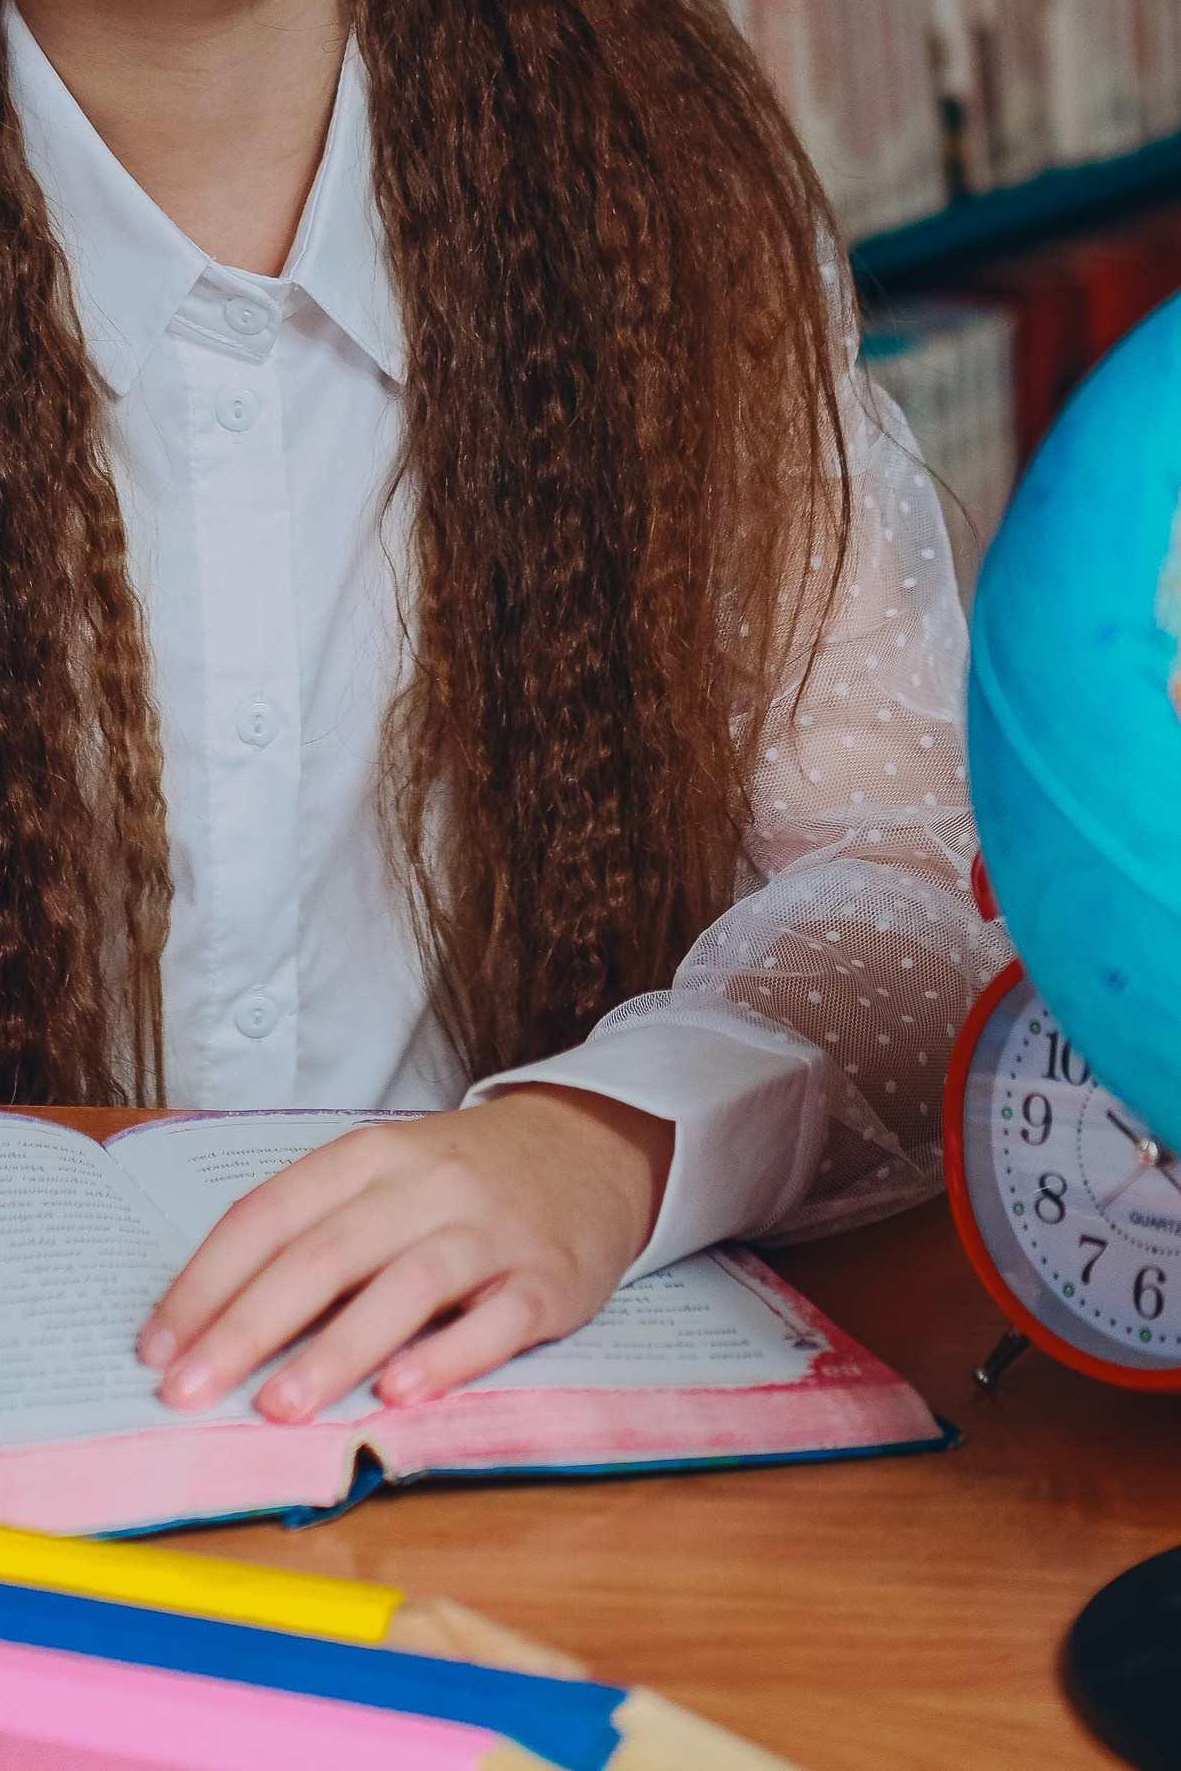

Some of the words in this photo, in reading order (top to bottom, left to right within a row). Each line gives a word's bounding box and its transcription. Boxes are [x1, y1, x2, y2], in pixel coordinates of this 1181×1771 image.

[1043, 1029, 1093, 1087] 10
[1022, 1092, 1053, 1146] 9
[1035, 1171, 1068, 1225] 8
[1078, 1234, 1109, 1285] 7
[1132, 1265, 1166, 1321] 6
